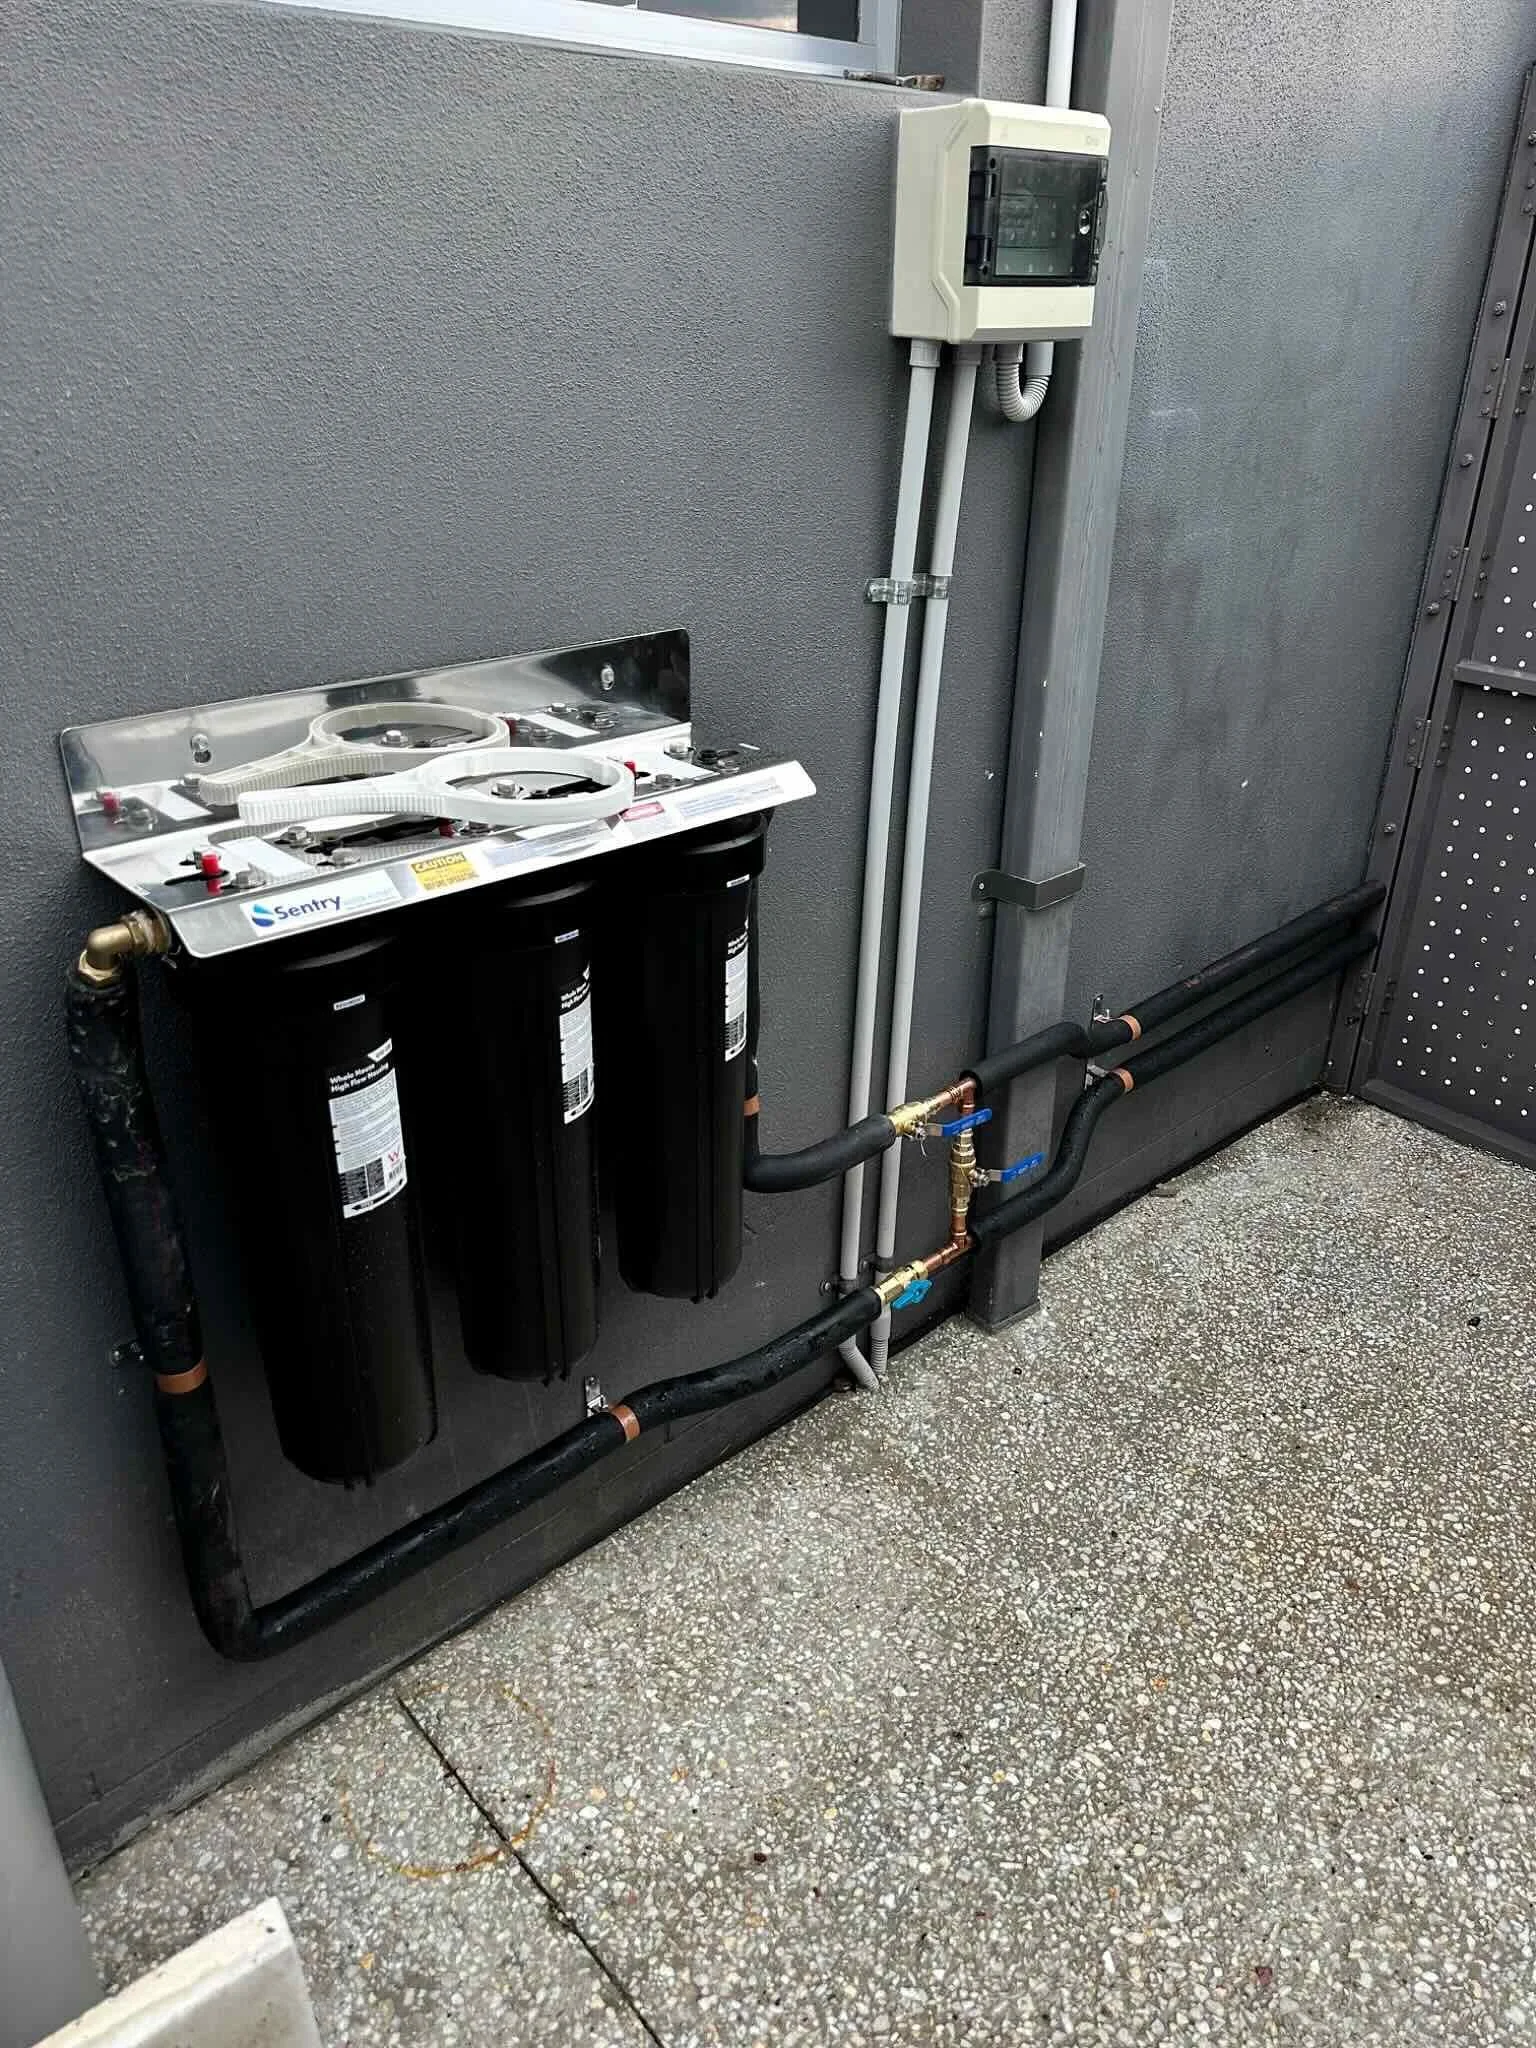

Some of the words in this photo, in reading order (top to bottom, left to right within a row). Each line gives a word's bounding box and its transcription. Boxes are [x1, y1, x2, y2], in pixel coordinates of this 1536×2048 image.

[414, 853, 466, 871] CAUTION
[274, 895, 341, 920] Sentry
[329, 1072, 354, 1084] Whole
[331, 1081, 350, 1092] High
[350, 1076, 367, 1087] Flow
